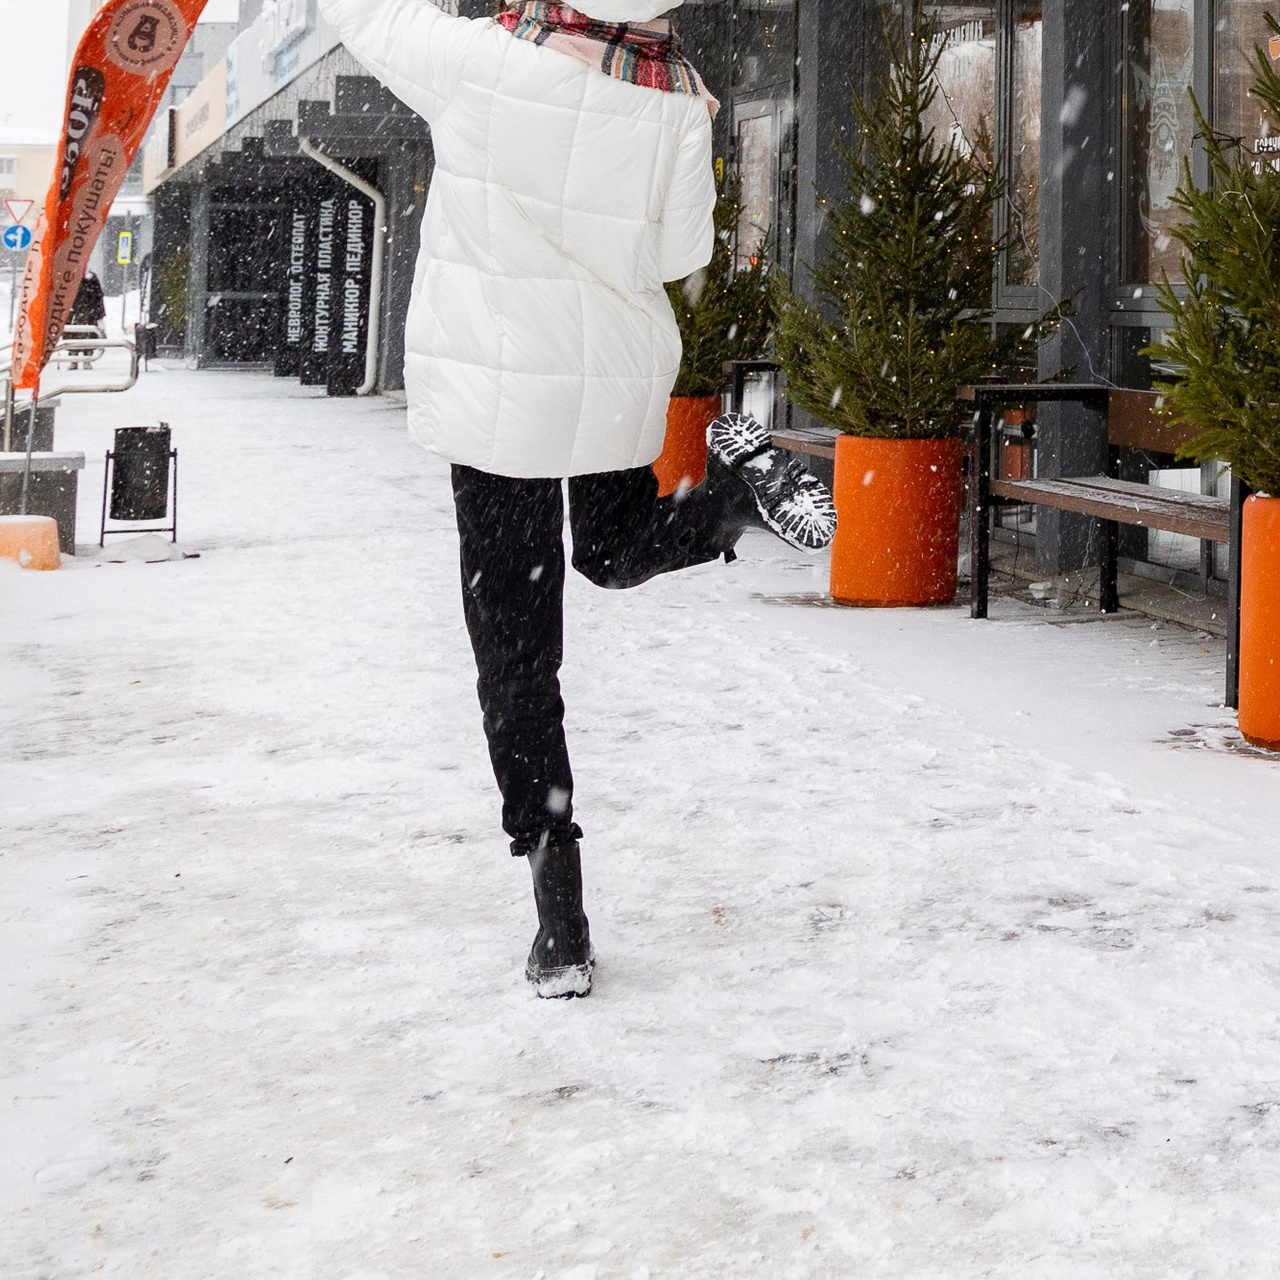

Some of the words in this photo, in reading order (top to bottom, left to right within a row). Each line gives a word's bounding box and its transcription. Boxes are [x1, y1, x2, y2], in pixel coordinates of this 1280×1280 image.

[67, 147, 117, 264] покушать!
[346, 199, 364, 272] ПЕДИКЮР
[291, 213, 305, 275] ОСТЕОПАТ
[342, 275, 362, 353] МАНИКЮР,
